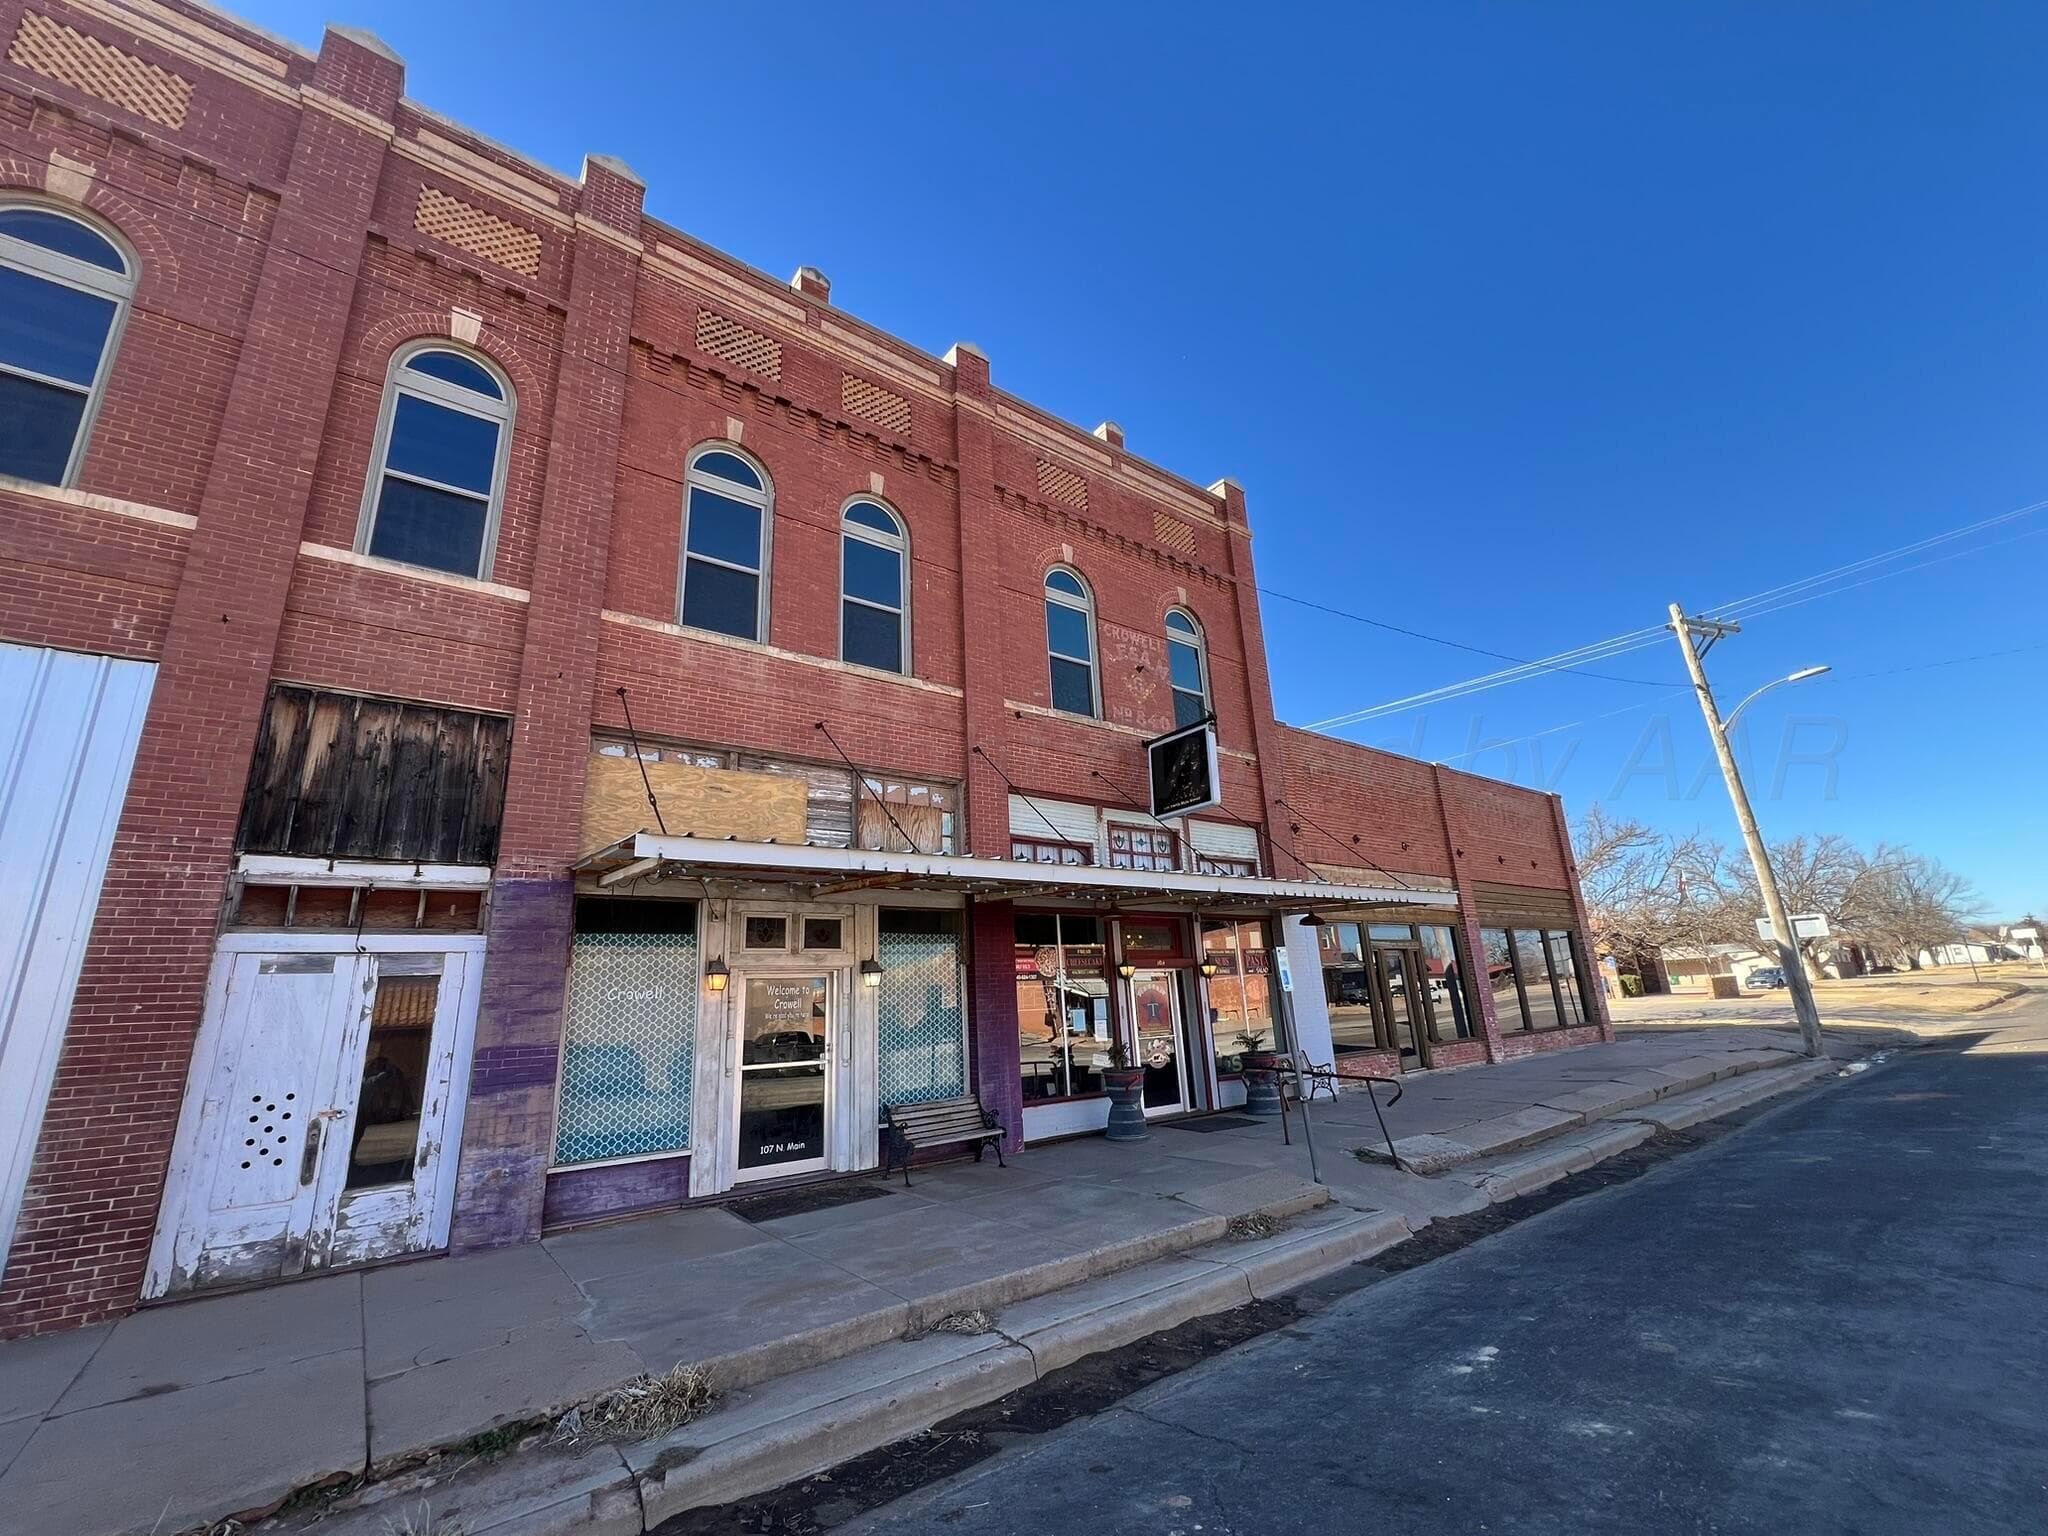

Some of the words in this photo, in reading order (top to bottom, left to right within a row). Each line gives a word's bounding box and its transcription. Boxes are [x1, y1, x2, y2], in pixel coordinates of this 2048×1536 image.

[1246, 954, 1269, 966] PASTA
[607, 986, 663, 1001] Crowell
[766, 984, 800, 996] Welcome
[802, 986, 810, 995] to
[774, 998, 802, 1009] Crowell
[1147, 1003, 1159, 1017] T
[760, 1144, 774, 1155] 107
[786, 1141, 806, 1151] Main
